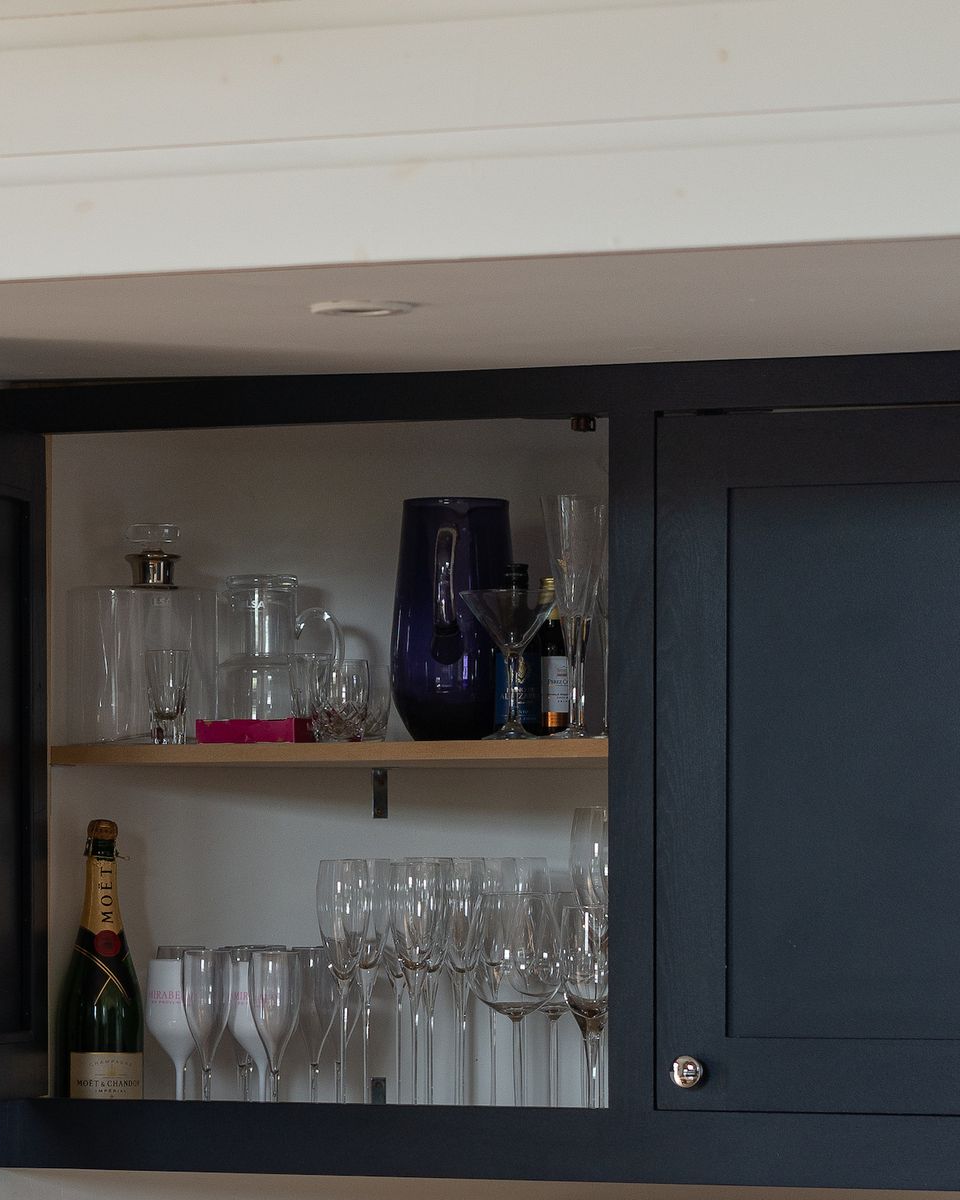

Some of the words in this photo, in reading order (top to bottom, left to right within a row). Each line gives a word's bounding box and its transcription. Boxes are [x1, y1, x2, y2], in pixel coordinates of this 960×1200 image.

[247, 600, 265, 609] LSA
[97, 866, 114, 924] MOËT
[148, 990, 184, 1001] MIRABE
